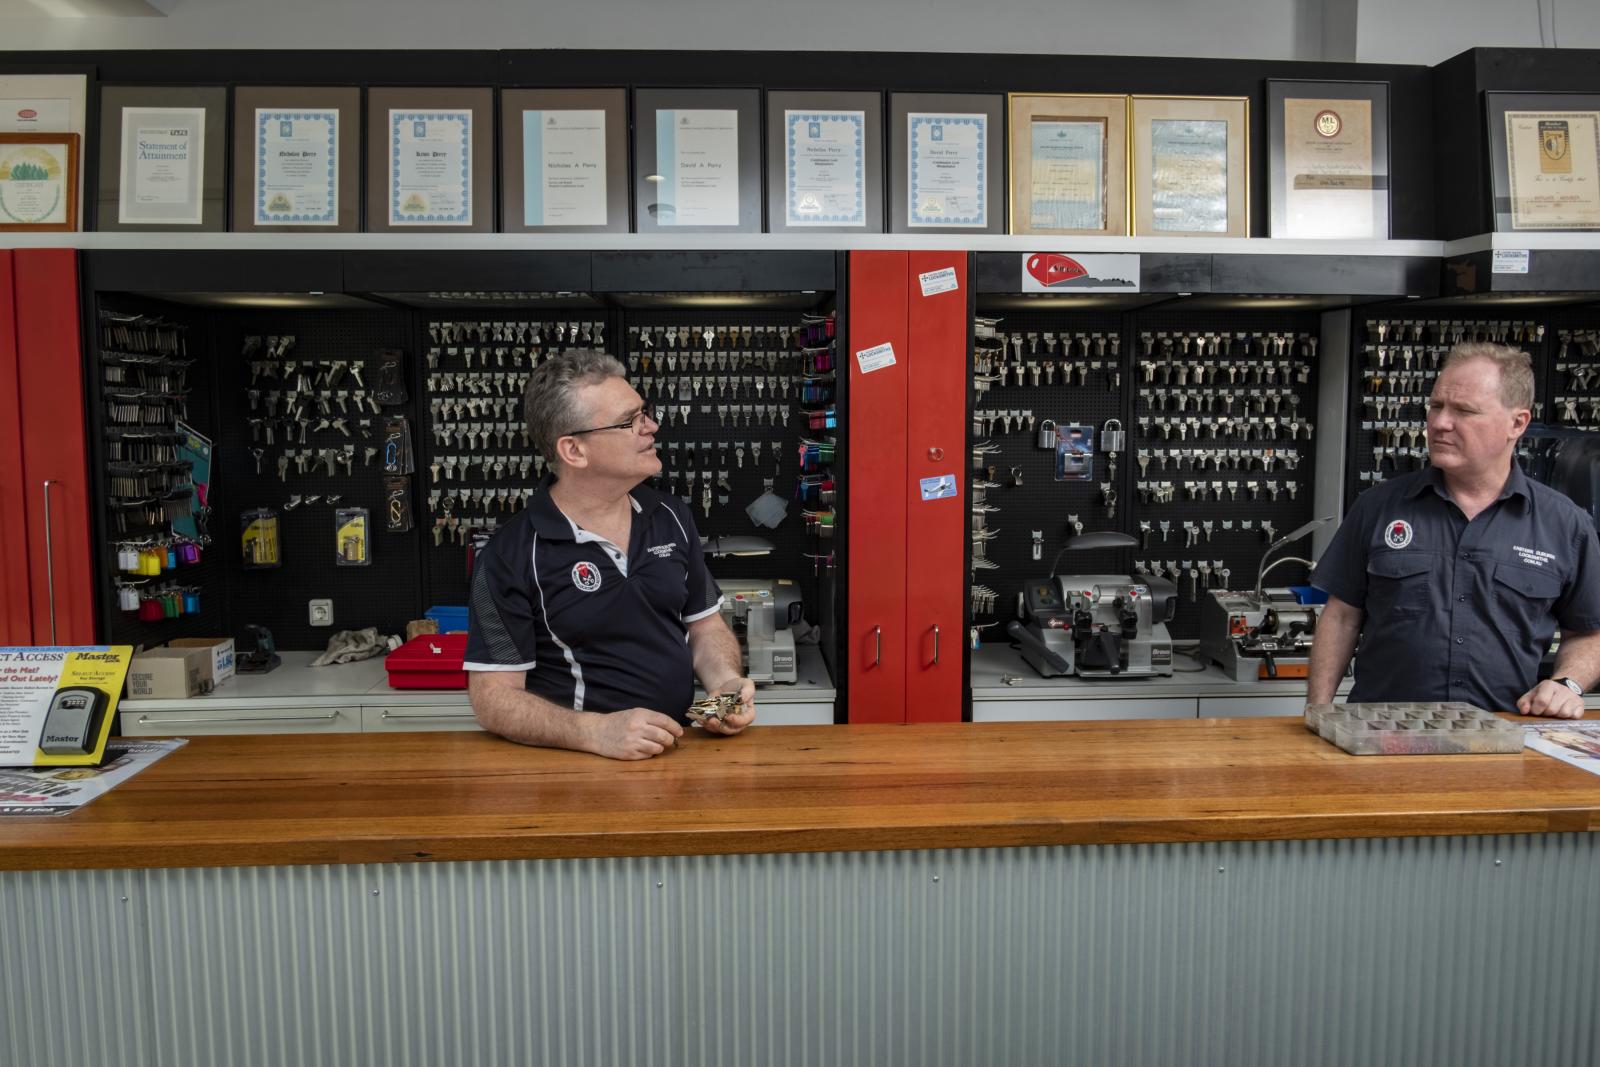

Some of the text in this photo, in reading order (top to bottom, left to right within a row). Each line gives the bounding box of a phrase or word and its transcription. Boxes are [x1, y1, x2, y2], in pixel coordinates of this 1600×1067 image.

[138, 140, 188, 150] Statement of
[138, 150, 188, 160] Attainment
[13, 652, 64, 661] ACCESS
[29, 675, 58, 683] Lately?
[131, 673, 153, 681] SECURE
[46, 735, 79, 743] Master
